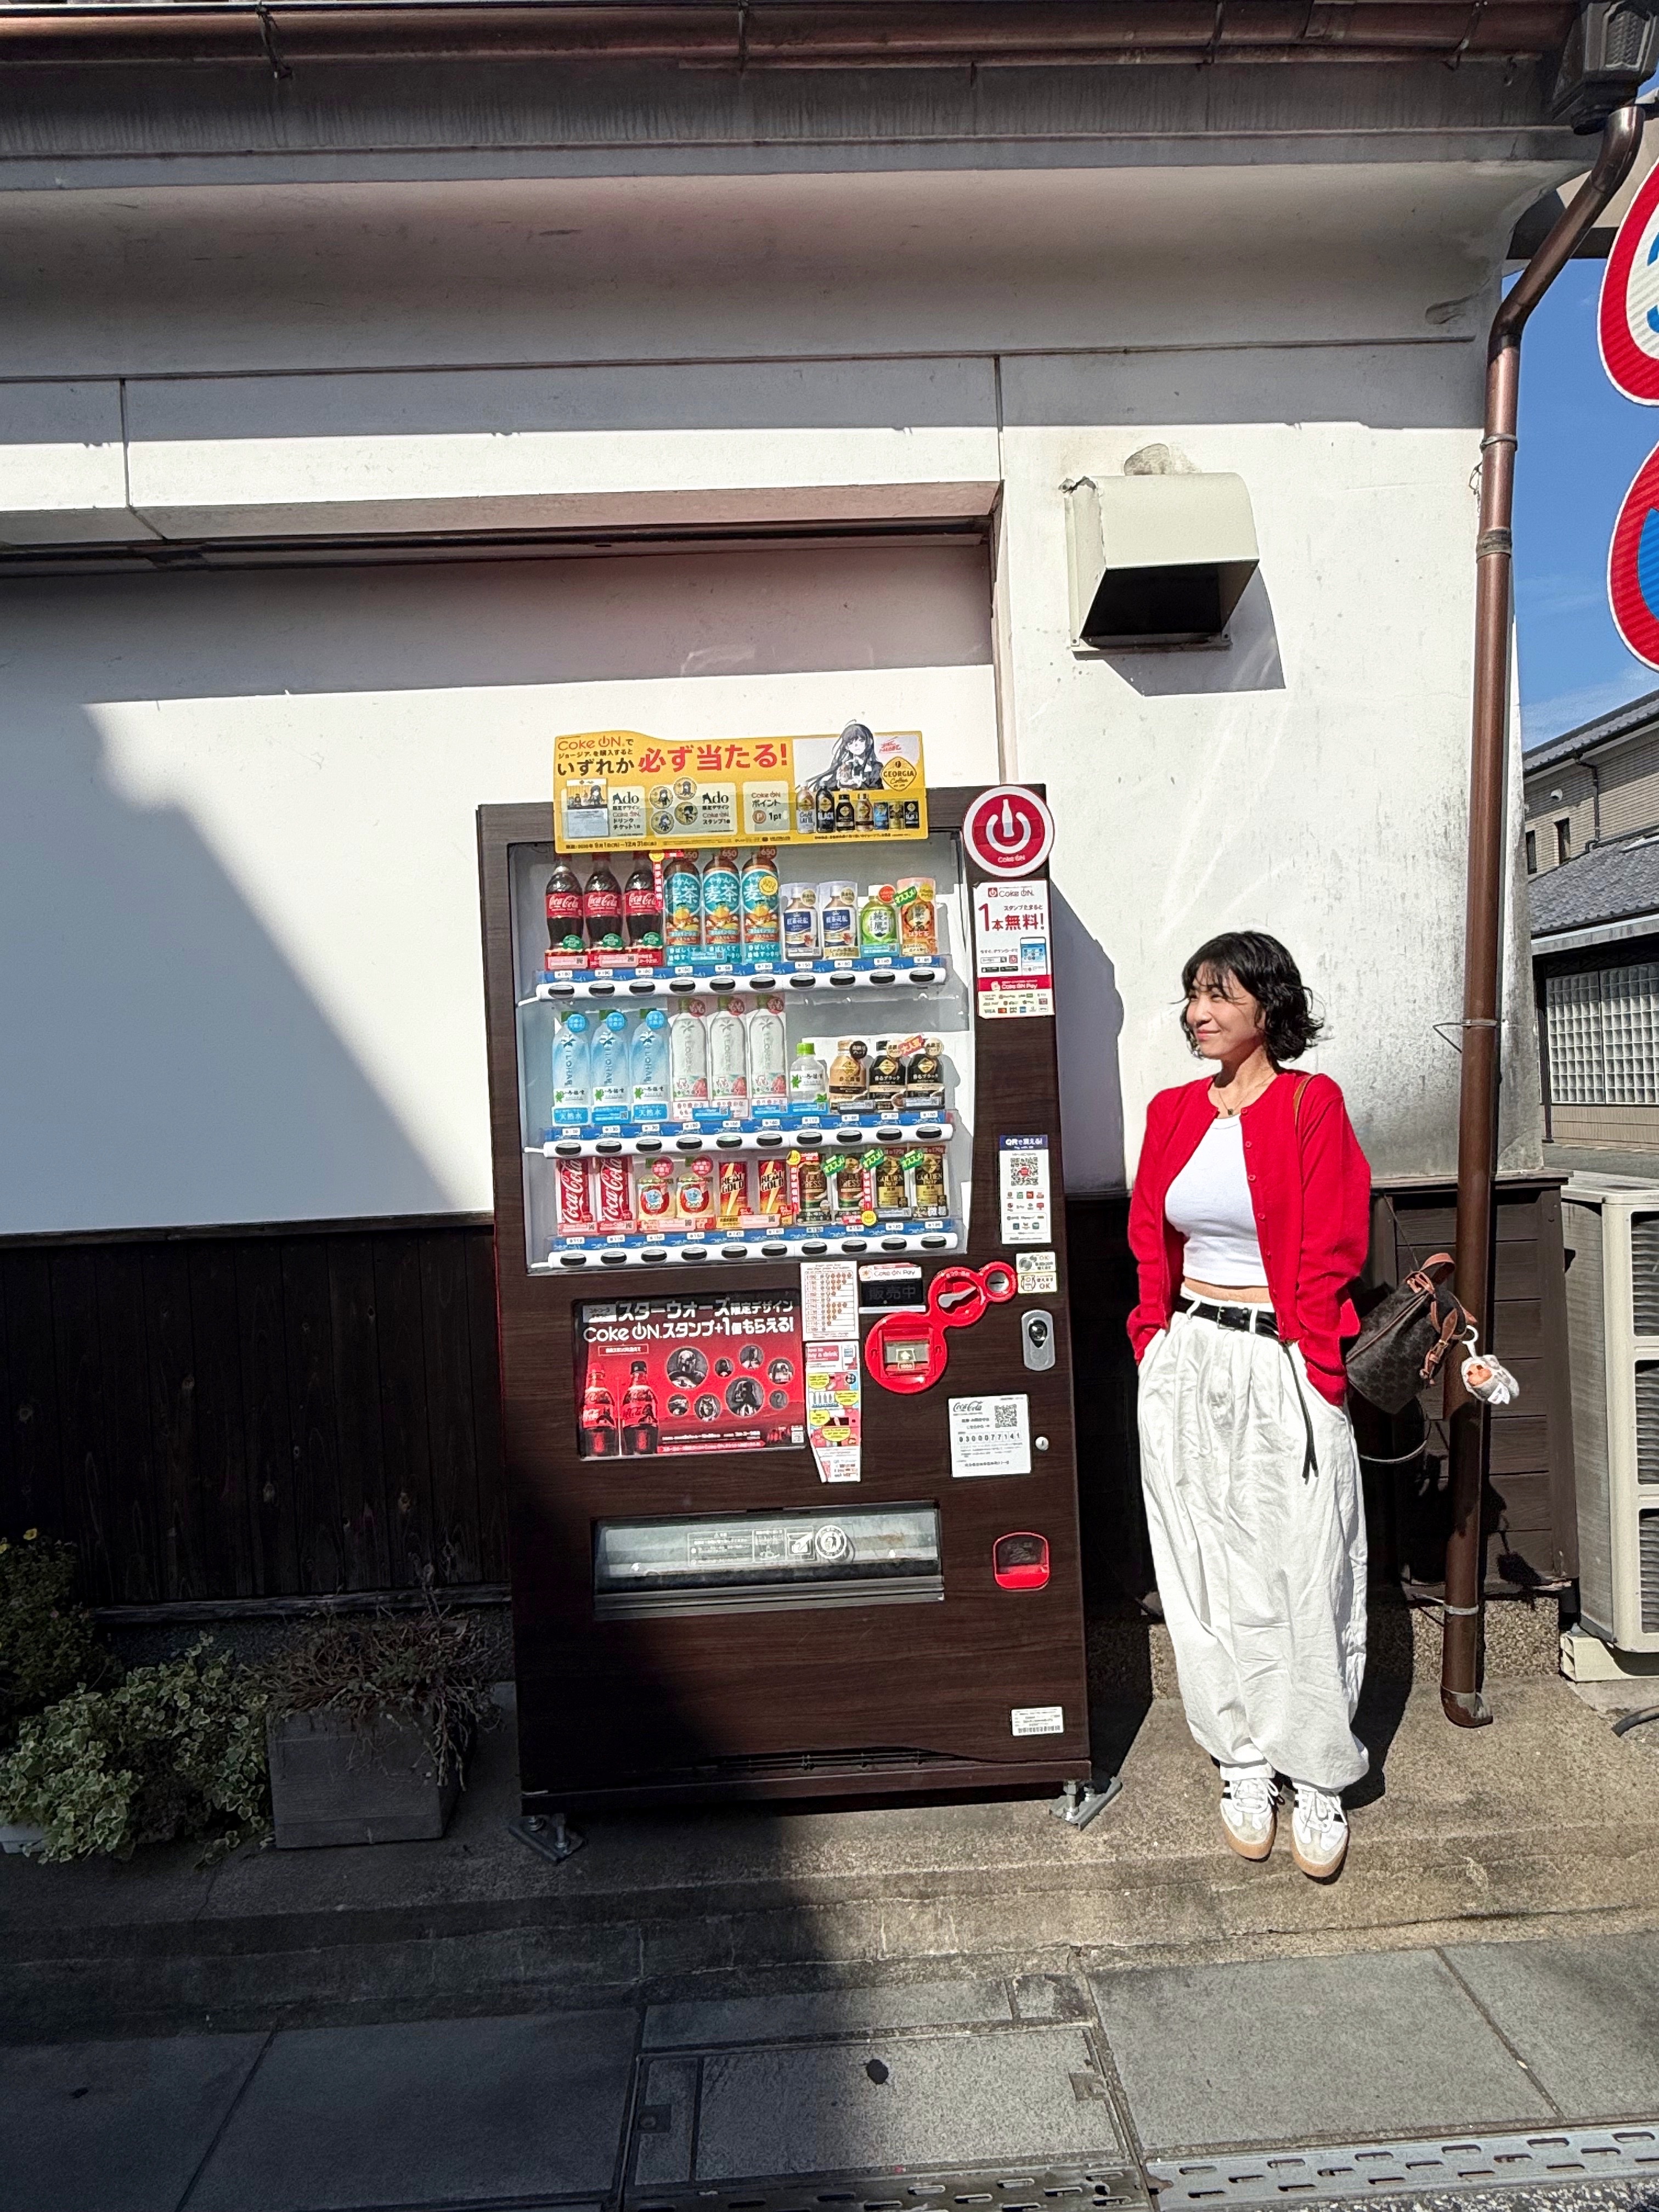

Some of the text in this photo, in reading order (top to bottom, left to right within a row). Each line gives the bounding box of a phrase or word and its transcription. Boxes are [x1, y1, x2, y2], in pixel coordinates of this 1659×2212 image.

[557, 740, 595, 751] Coke
[557, 743, 788, 776] いずれか 必ず当たる!
[883, 770, 915, 778] GEORGIA
[612, 791, 640, 804] Ado
[702, 791, 729, 804] Ado
[768, 812, 781, 821] 1pt
[705, 885, 738, 904] 麦茶
[978, 903, 1045, 932] 1本無料!
[722, 1171, 745, 1184] REAL
[761, 1169, 785, 1182] REAL
[560, 1159, 584, 1224] Coca-Cola
[600, 1157, 624, 1221] Coca-Cola
[722, 1181, 745, 1194] GOLD
[761, 1178, 784, 1192] GOLD
[868, 1285, 917, 1301] 販売中
[583, 1326, 630, 1343] Coke
[953, 1400, 984, 1413] Coca-Cola
